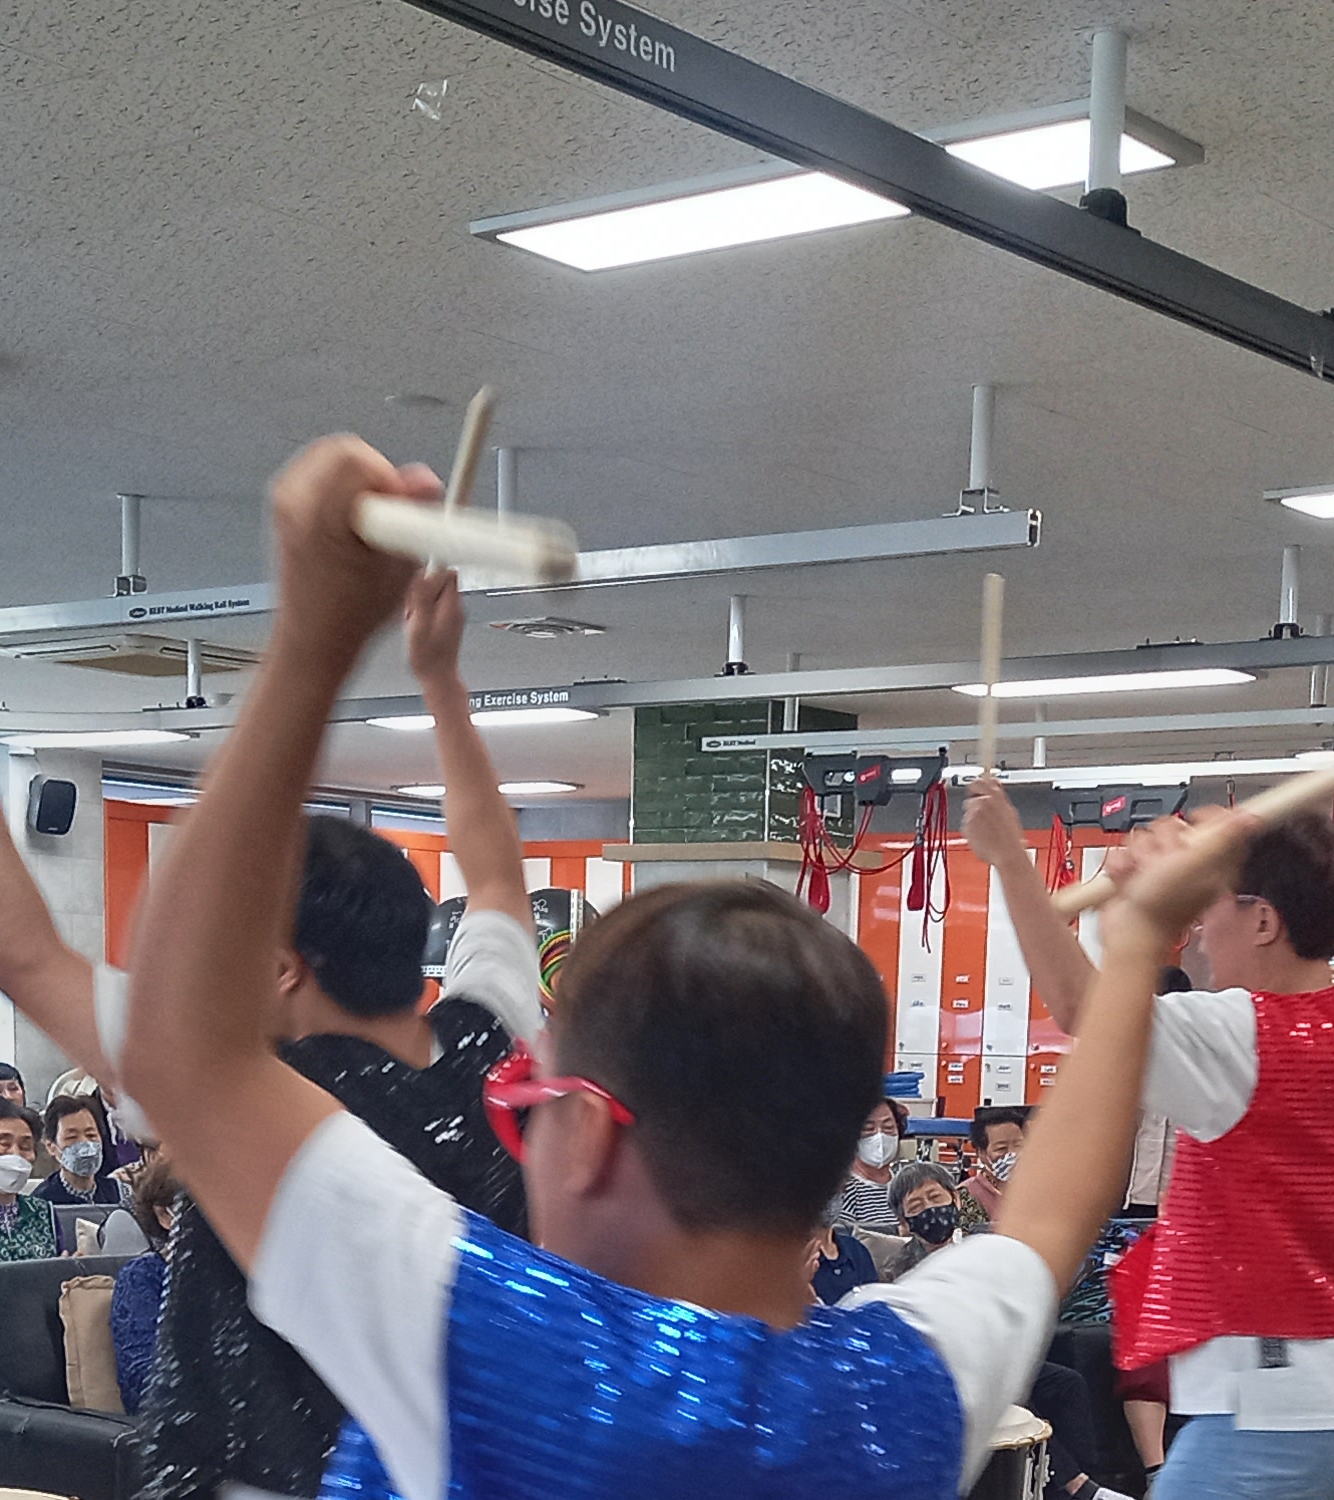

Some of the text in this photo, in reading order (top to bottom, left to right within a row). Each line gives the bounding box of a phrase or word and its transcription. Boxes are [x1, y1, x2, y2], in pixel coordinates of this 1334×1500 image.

[579, 1, 675, 72] System
[484, 694, 528, 707] Exercise
[530, 691, 569, 704] System
